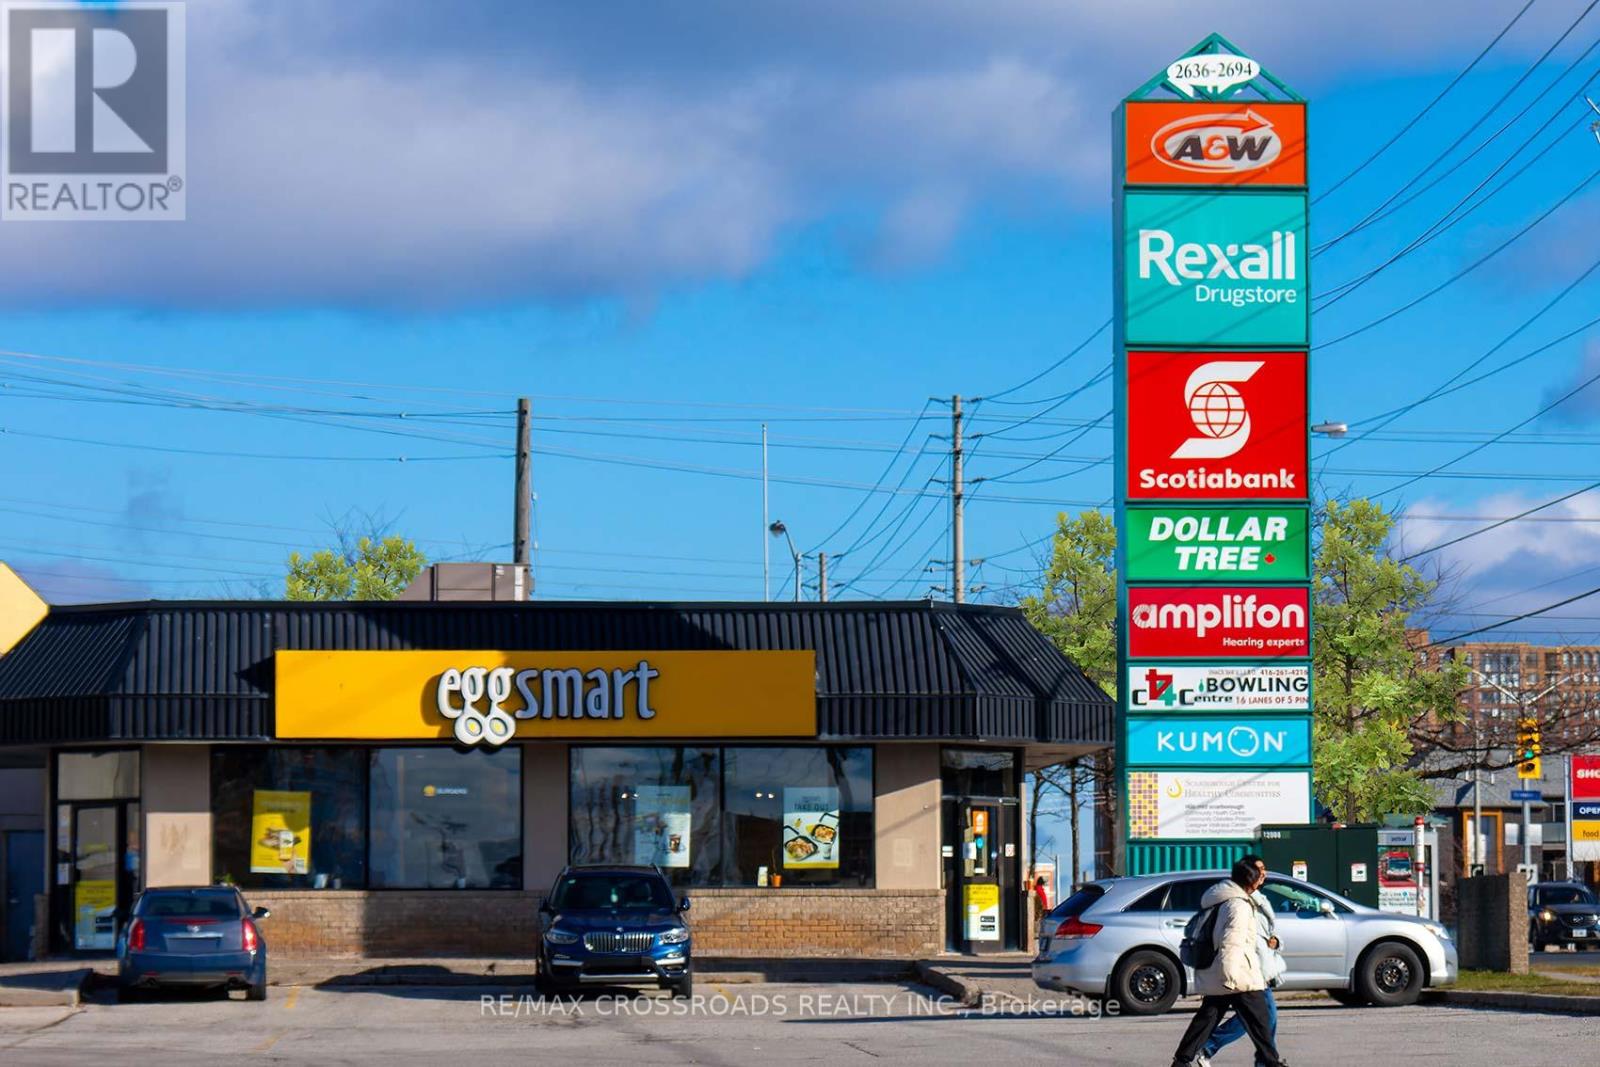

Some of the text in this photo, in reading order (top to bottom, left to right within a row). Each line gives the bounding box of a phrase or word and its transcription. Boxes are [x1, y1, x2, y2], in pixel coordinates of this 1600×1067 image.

[1175, 62, 1252, 79] 2636-2694
[1171, 134, 1273, 161] A&W
[1139, 229, 1296, 286] Rexall
[1195, 285, 1297, 307] Drugstore
[1139, 467, 1296, 489] Scotiabank
[1148, 516, 1288, 541] DOLLAR
[1174, 546, 1262, 571] TREE
[1132, 594, 1305, 637] amplifon
[1222, 637, 1305, 648] Hearing experts
[1206, 677, 1309, 693] BOWLING
[437, 660, 659, 745] eggsmart
[1236, 696, 1246, 704] 16
[1248, 696, 1273, 704] LANES
[1287, 696, 1293, 704] 5
[1157, 726, 1284, 757] KUMON
